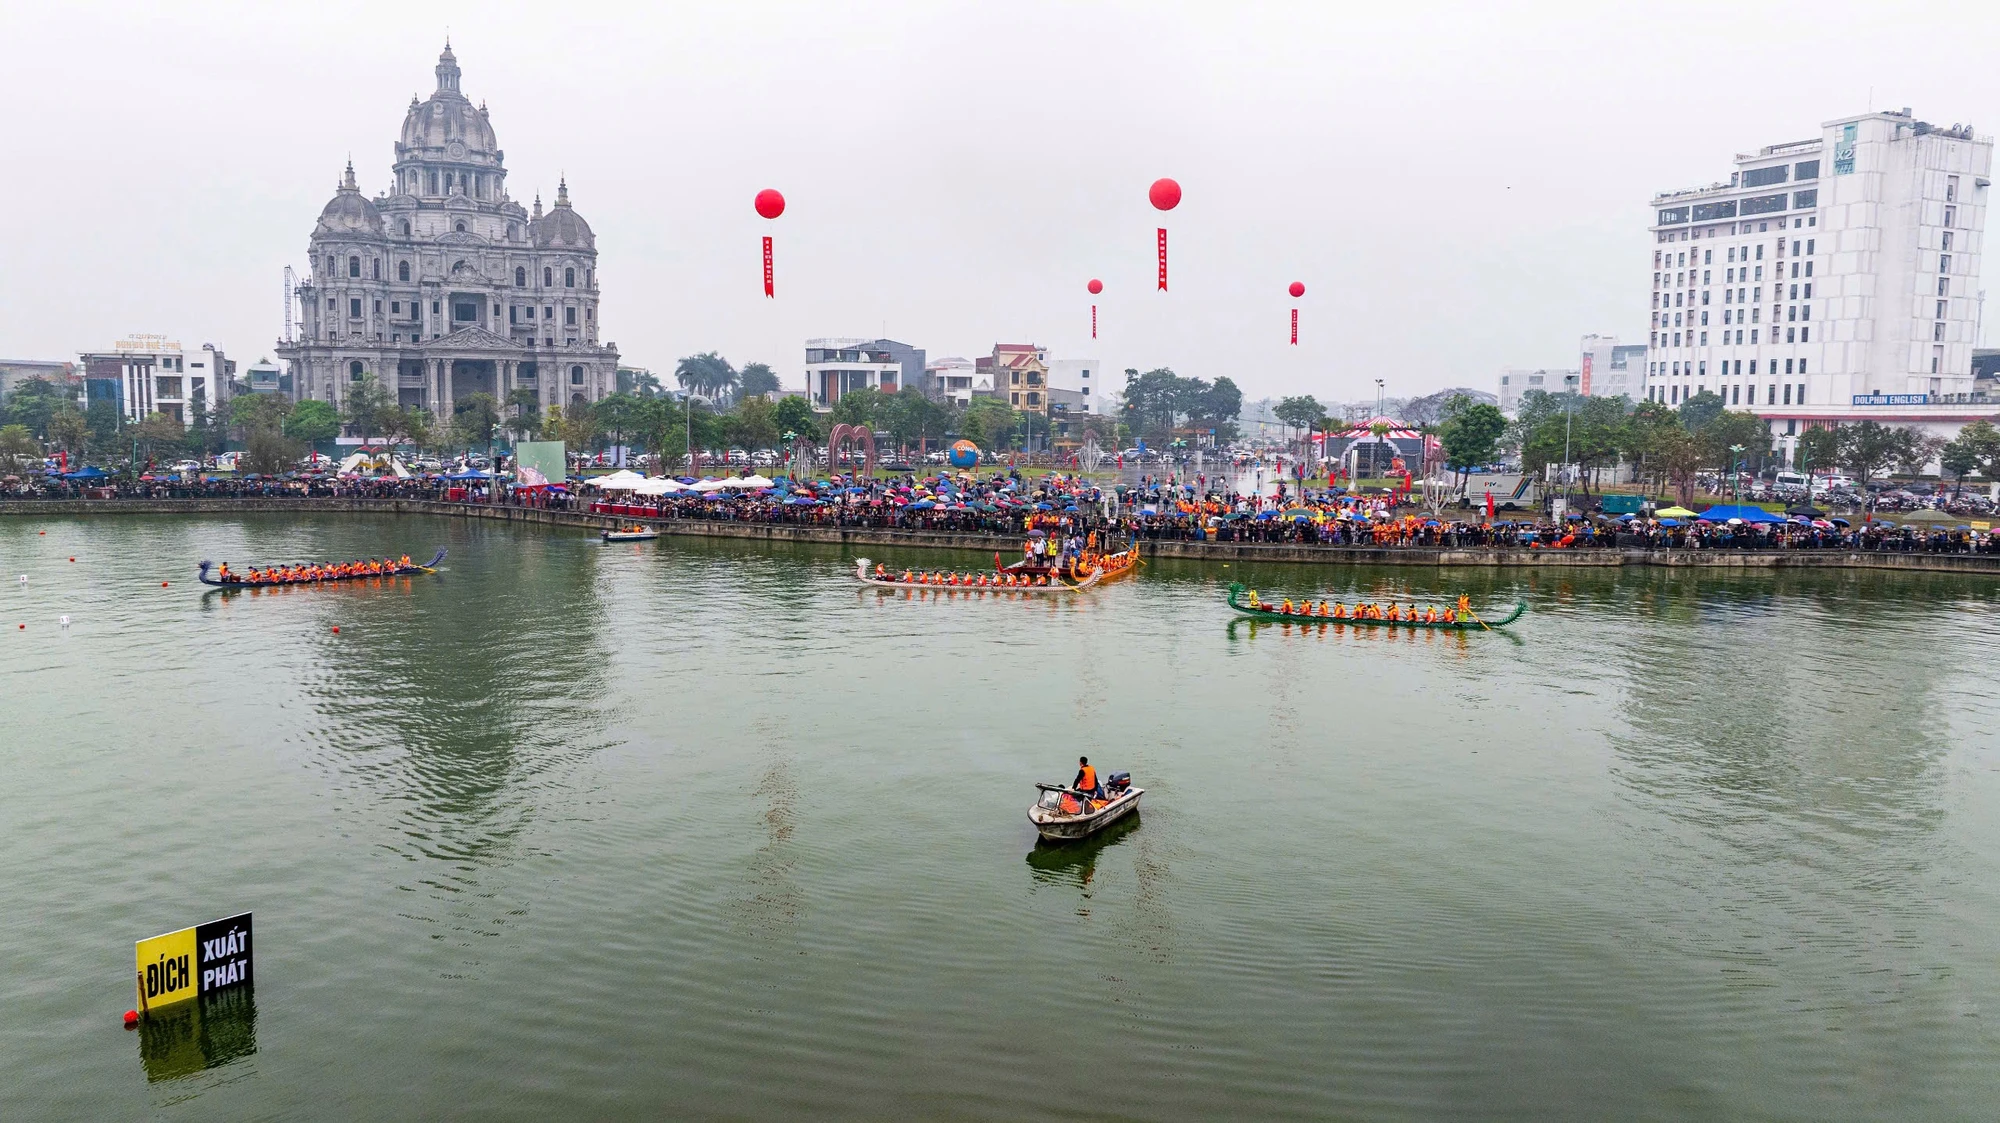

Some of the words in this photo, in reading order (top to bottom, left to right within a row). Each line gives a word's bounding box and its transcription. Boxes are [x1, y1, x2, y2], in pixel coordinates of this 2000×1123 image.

[1836, 149, 1854, 160] X2
[1854, 395, 1888, 405] DOLPHIN
[1889, 395, 1924, 404] ENGLISH
[203, 925, 247, 963] XUẤT
[146, 953, 189, 999] ĐÍCH
[203, 958, 247, 992] PHÁT
